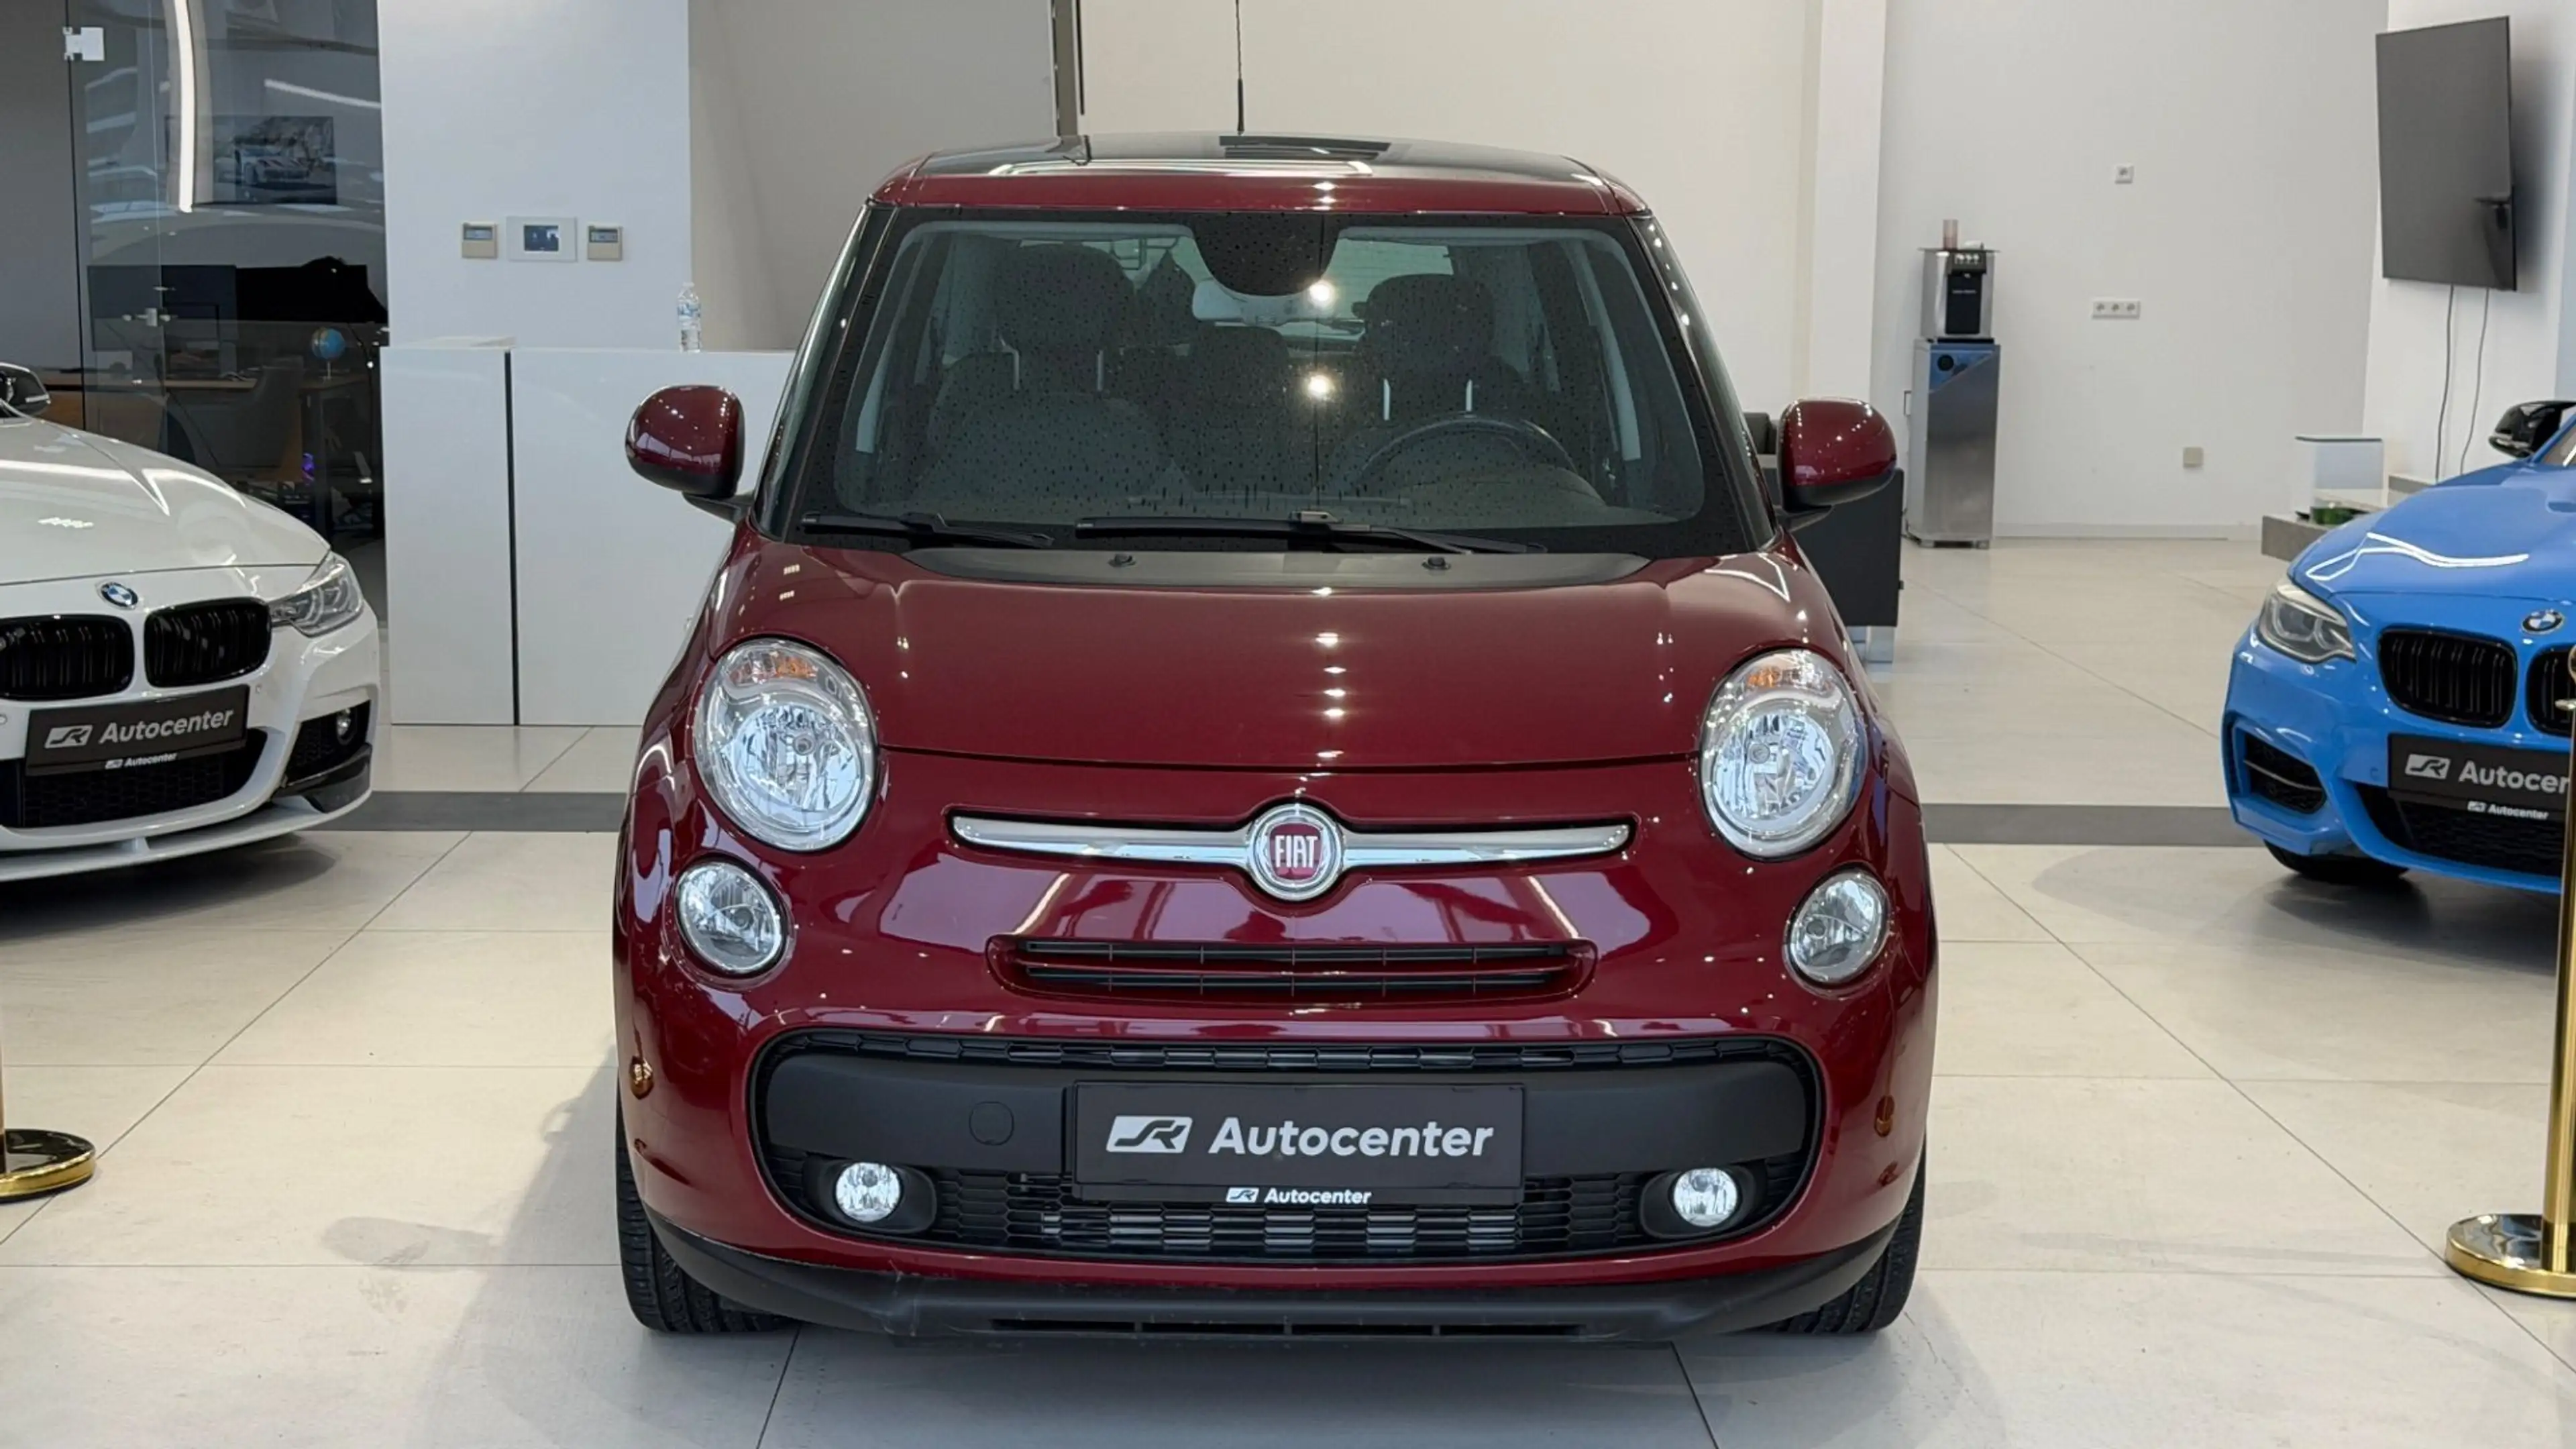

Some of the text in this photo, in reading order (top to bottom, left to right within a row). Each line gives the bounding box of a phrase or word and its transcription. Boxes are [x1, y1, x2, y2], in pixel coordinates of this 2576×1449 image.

[98, 708, 233, 745] Autocenter
[123, 752, 177, 768] Autocenter
[2487, 804, 2548, 819] Autocenter
[1275, 835, 1318, 868] FIAT
[1208, 1117, 1494, 1157] Autocenter
[1264, 1187, 1372, 1204] Autocenter
